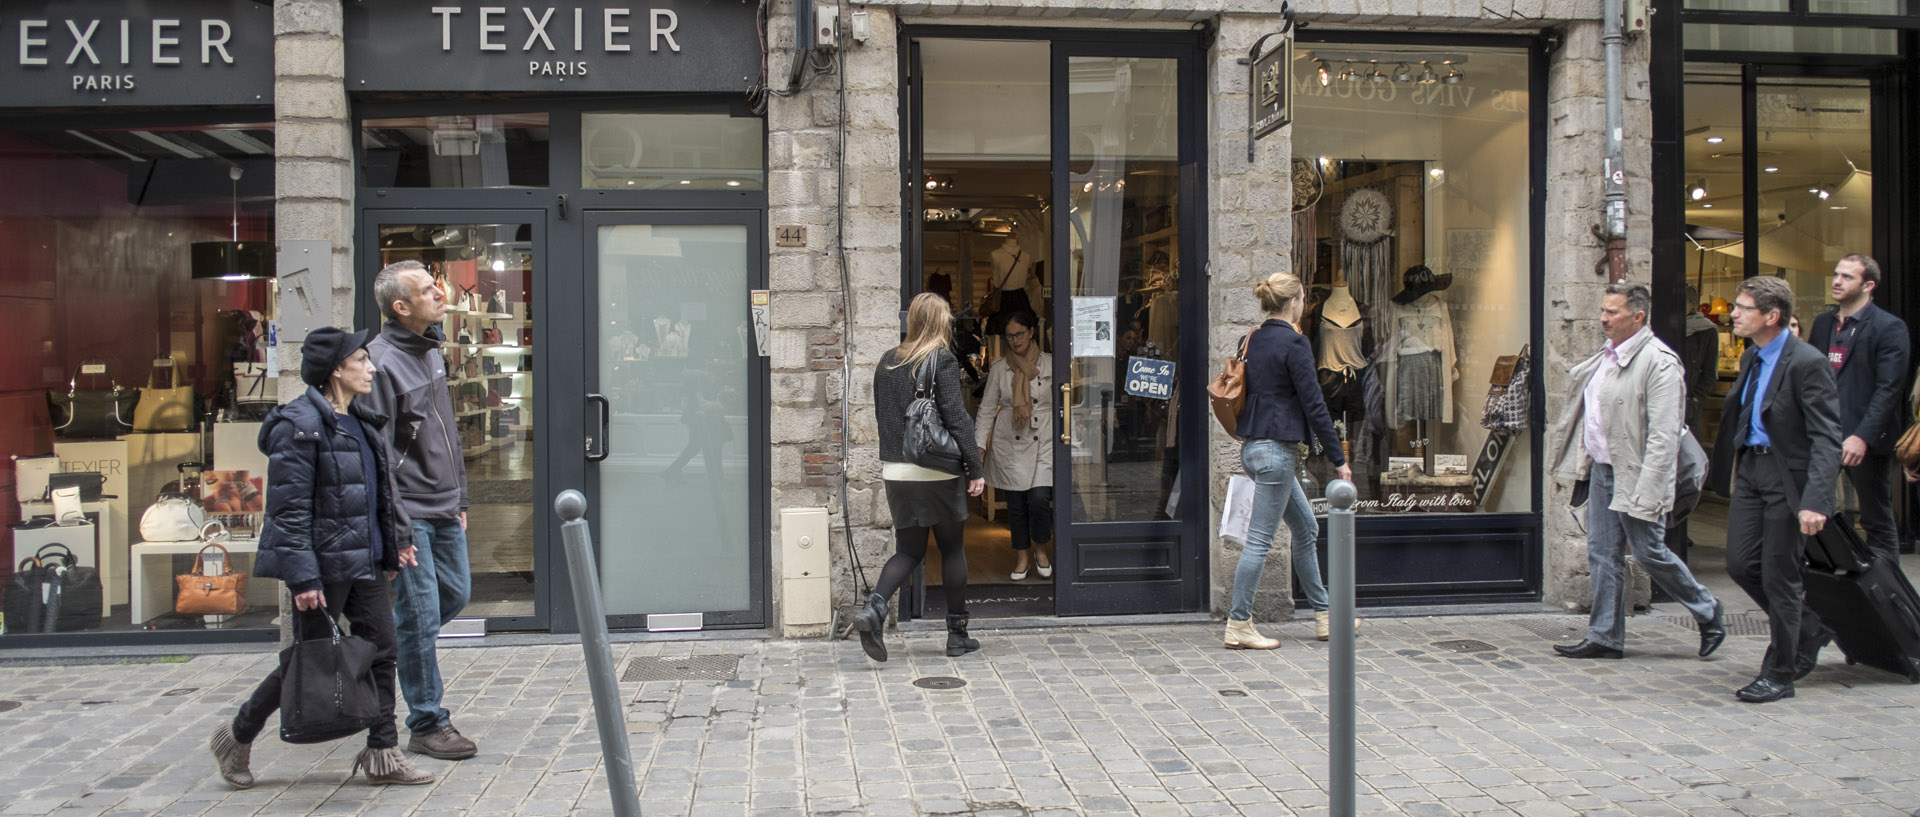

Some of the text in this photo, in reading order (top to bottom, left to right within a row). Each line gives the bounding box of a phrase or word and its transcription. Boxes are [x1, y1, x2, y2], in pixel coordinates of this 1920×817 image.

[431, 7, 681, 52] TEXIER
[529, 60, 588, 76] PARIS
[73, 74, 135, 90] PARIS
[780, 228, 802, 242] 44
[1132, 360, 1170, 377] Come In
[1129, 379, 1169, 396] OPEN
[60, 459, 122, 476] TEXIER
[1312, 502, 1328, 514] HOM
[1381, 493, 1418, 509] Italy
[1416, 494, 1445, 507] with
[1448, 493, 1472, 507] love
